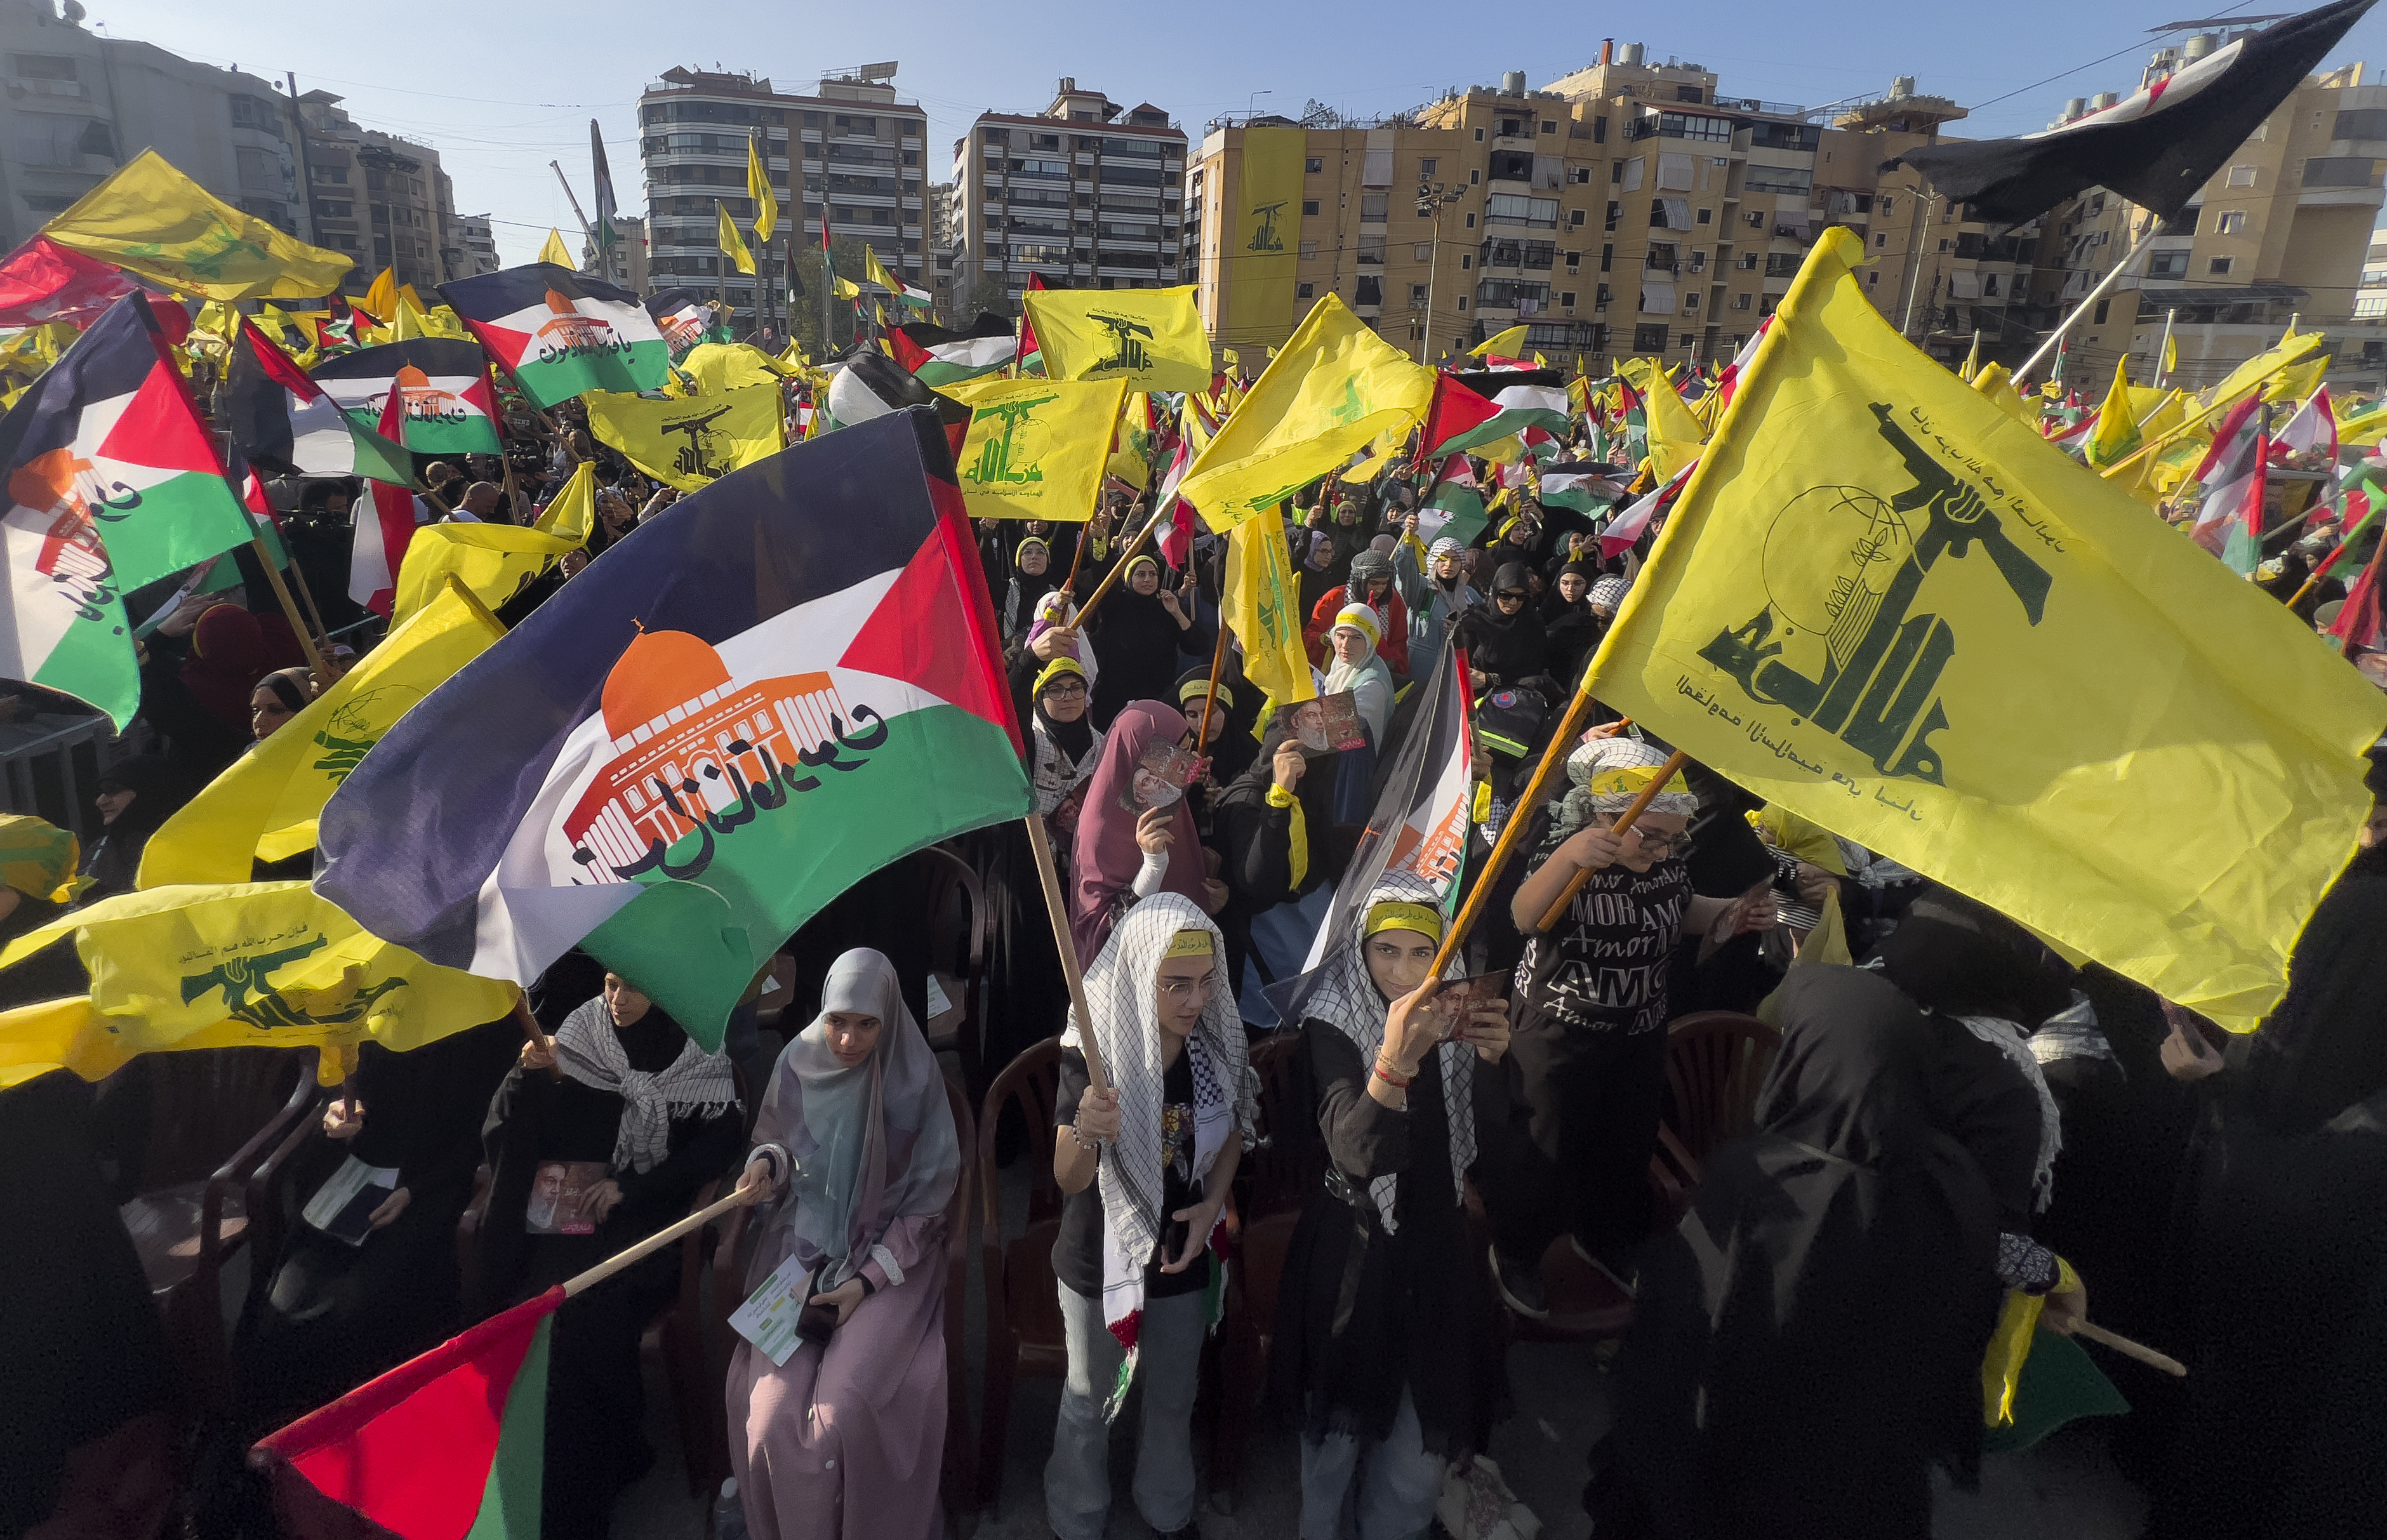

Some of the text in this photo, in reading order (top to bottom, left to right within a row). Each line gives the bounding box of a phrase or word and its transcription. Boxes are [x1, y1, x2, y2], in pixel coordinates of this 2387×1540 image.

[1565, 893, 1637, 926] MOR
[1187, 938, 1202, 953] طريق
[1562, 924, 1656, 959] Amor
